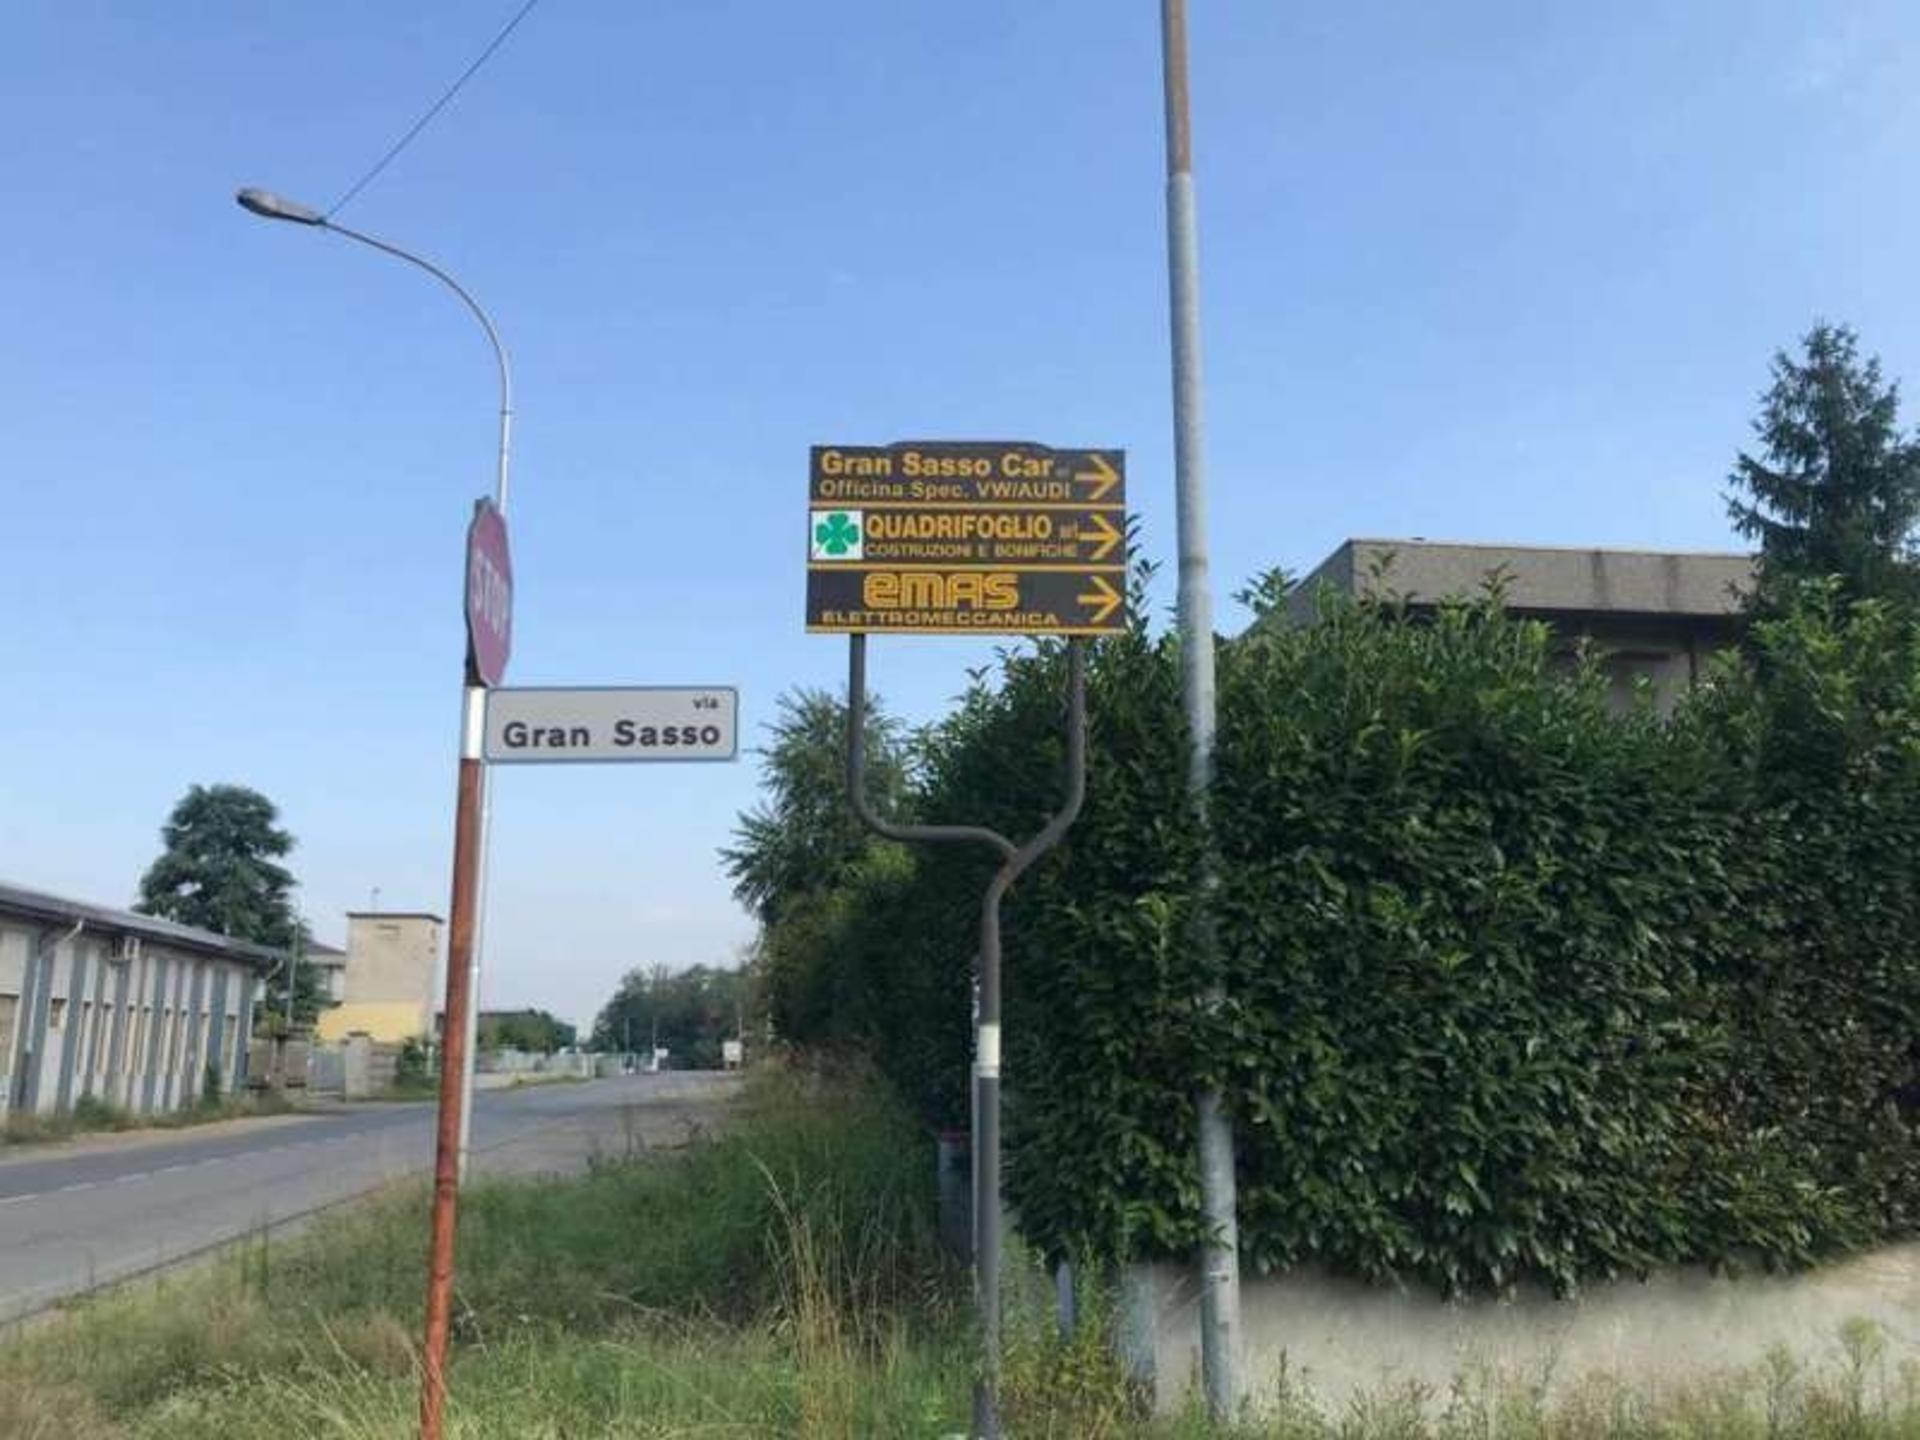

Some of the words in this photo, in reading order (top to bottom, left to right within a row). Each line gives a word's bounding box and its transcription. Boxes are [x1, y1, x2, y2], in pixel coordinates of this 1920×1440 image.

[820, 451, 891, 476] Gran
[902, 452, 991, 477] Sasso
[1001, 453, 1054, 476] Car
[819, 480, 903, 497] Officina
[910, 481, 969, 499] Spec.
[977, 482, 1071, 499] VW/AUDI
[866, 514, 1051, 539] QUADRIFOGLIO
[864, 543, 971, 557] COSTRUZIONI
[821, 611, 1058, 626] ELETTROMECCANICA
[692, 694, 719, 710] via
[502, 721, 591, 748] Gran
[613, 720, 721, 747] Sasso
